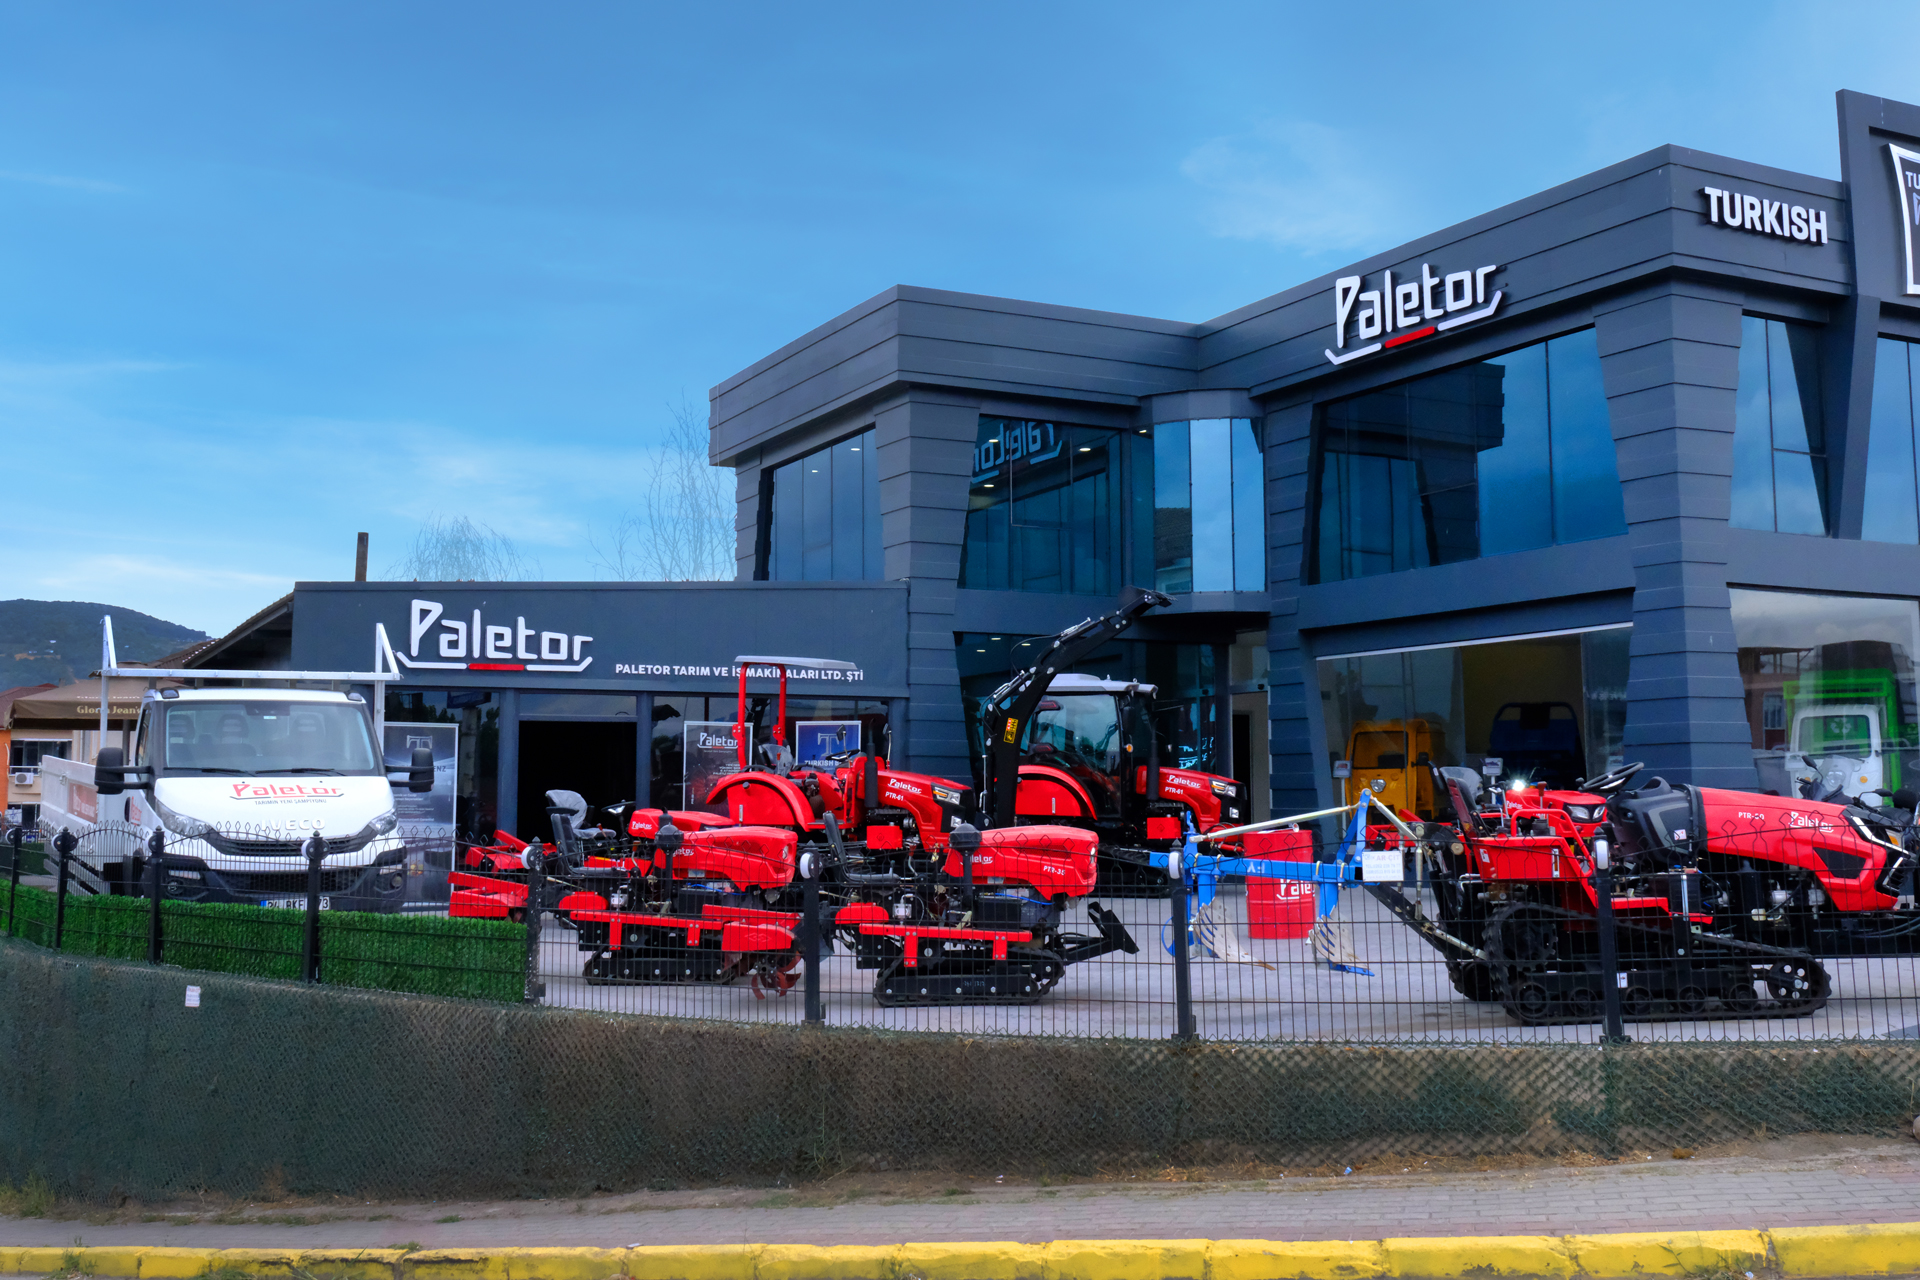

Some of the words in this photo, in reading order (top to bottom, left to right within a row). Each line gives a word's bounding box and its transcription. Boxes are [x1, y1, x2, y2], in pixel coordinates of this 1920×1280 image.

[1704, 186, 1828, 244] TURKISH
[1335, 263, 1498, 348] Paletor
[409, 599, 594, 663] Paletor
[615, 663, 671, 675] PALETOR
[672, 665, 711, 676] TARIM
[712, 666, 729, 677] VE
[820, 670, 845, 680] LTD.
[846, 669, 864, 682] ŞTİ
[699, 732, 738, 747] Paletor
[889, 778, 922, 794] Paletor
[1167, 774, 1202, 789] Paletor
[232, 783, 342, 797] Paletor
[260, 819, 326, 831] IVECO
